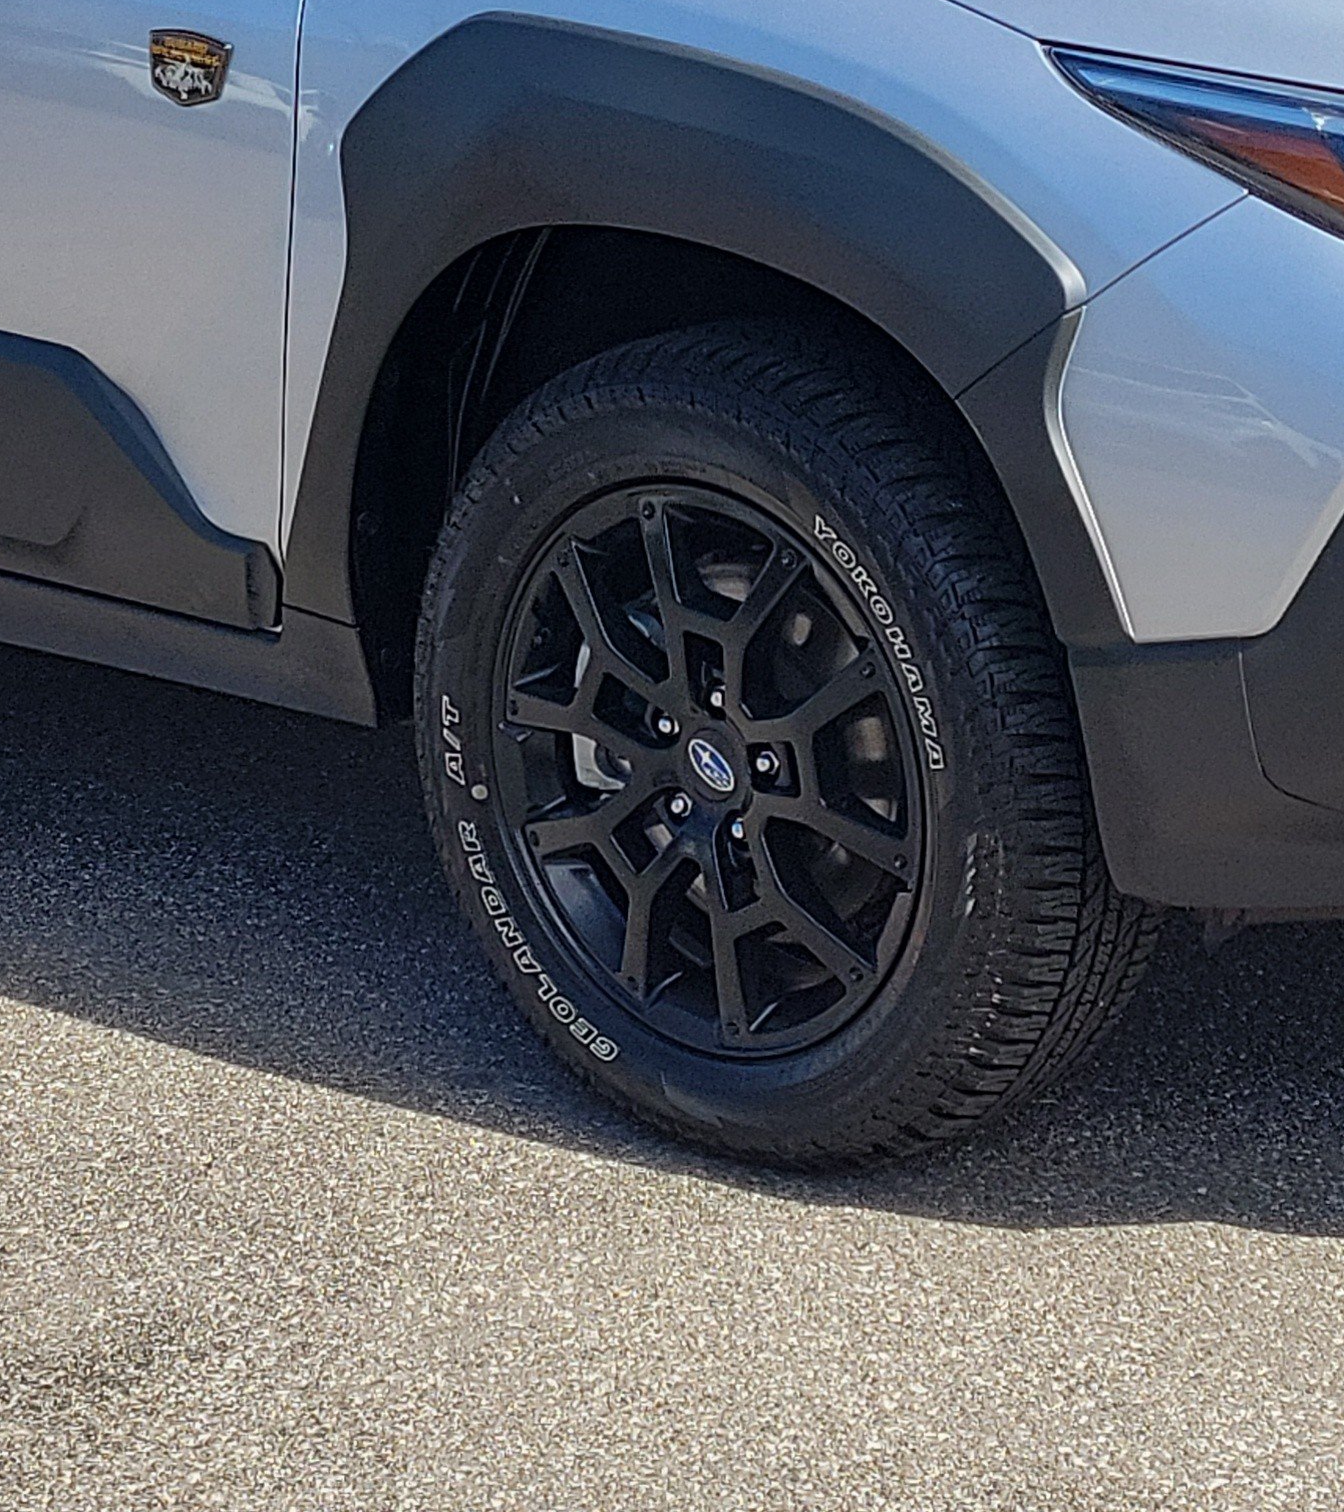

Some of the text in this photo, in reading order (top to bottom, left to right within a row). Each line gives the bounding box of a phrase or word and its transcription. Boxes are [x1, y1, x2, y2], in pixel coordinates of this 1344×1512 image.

[813, 513, 946, 771] YOKOHAMA
[440, 694, 619, 1062] GEOLANDAR A/T
